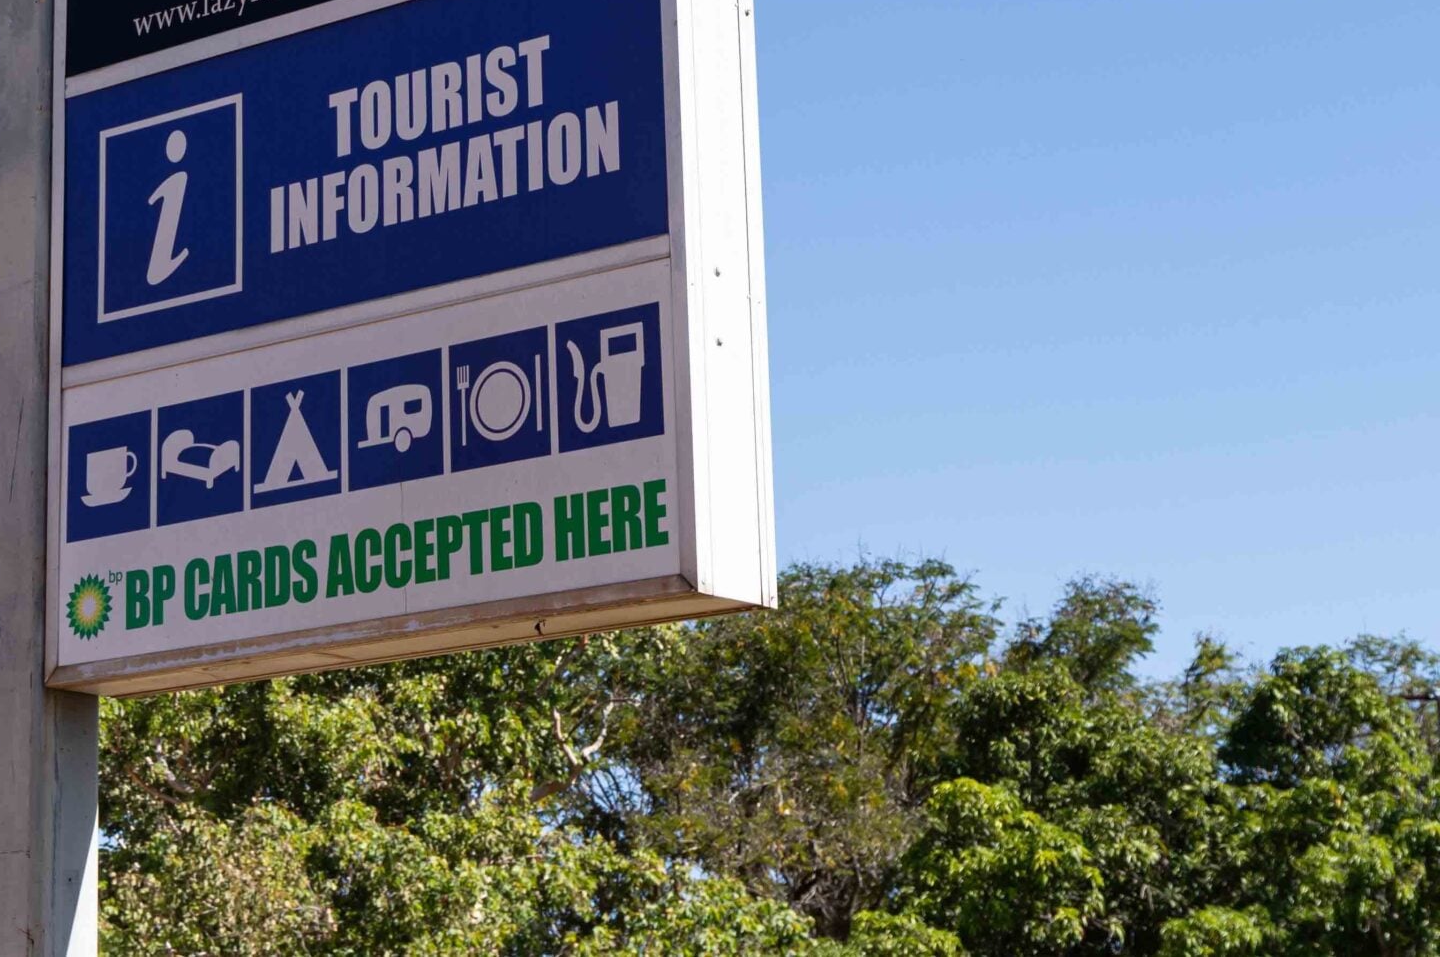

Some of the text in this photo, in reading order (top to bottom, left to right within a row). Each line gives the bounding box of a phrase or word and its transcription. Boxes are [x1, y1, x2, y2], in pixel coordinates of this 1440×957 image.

[329, 35, 550, 158] TOURIST
[270, 101, 621, 254] INFORMATION
[108, 569, 123, 586] bp
[125, 479, 670, 630] BP CARDS ACCEPTED HERE
